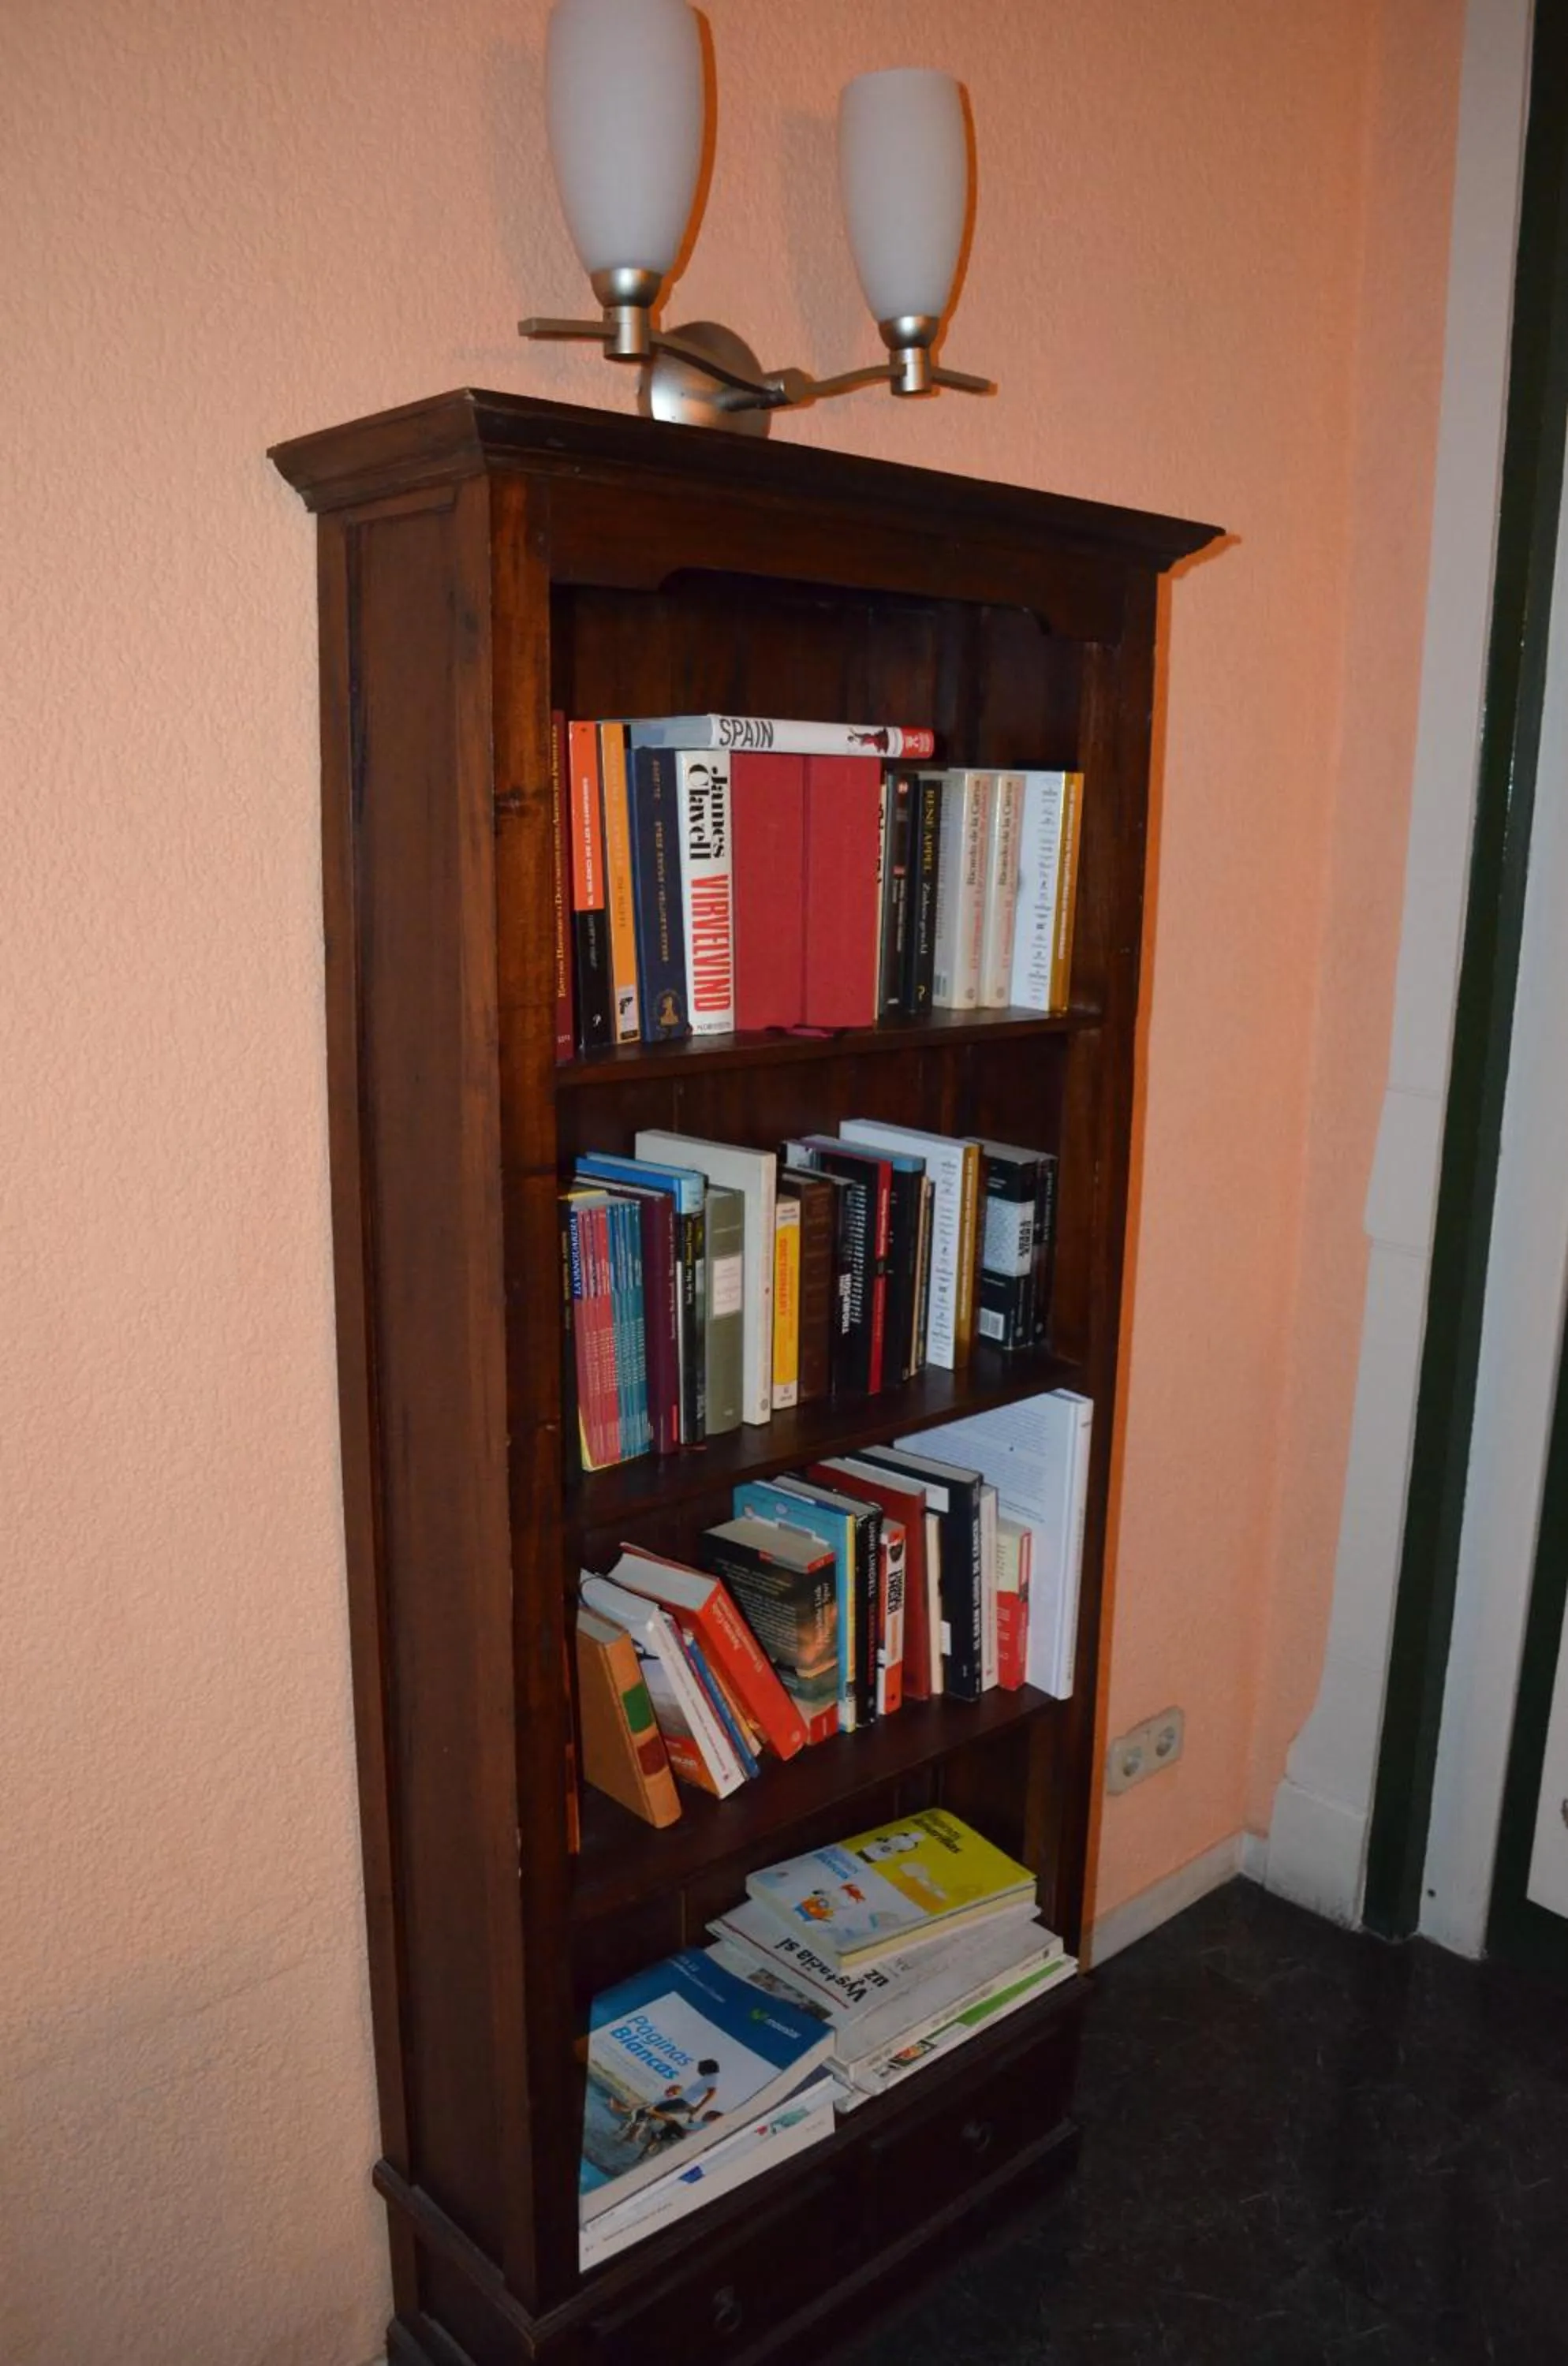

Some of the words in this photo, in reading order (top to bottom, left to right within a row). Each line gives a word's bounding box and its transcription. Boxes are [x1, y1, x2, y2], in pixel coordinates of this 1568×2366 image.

[719, 718, 775, 749] SPAIN
[689, 763, 710, 861] Clavell
[711, 767, 728, 859] James
[690, 874, 731, 1012] VIRVELVIND
[569, 1218, 581, 1280] VANGUARDIA
[573, 1281, 582, 1296] LA
[774, 1937, 801, 1952] si
[610, 2026, 680, 2080] Blancas
[627, 2014, 695, 2067] Páginas
